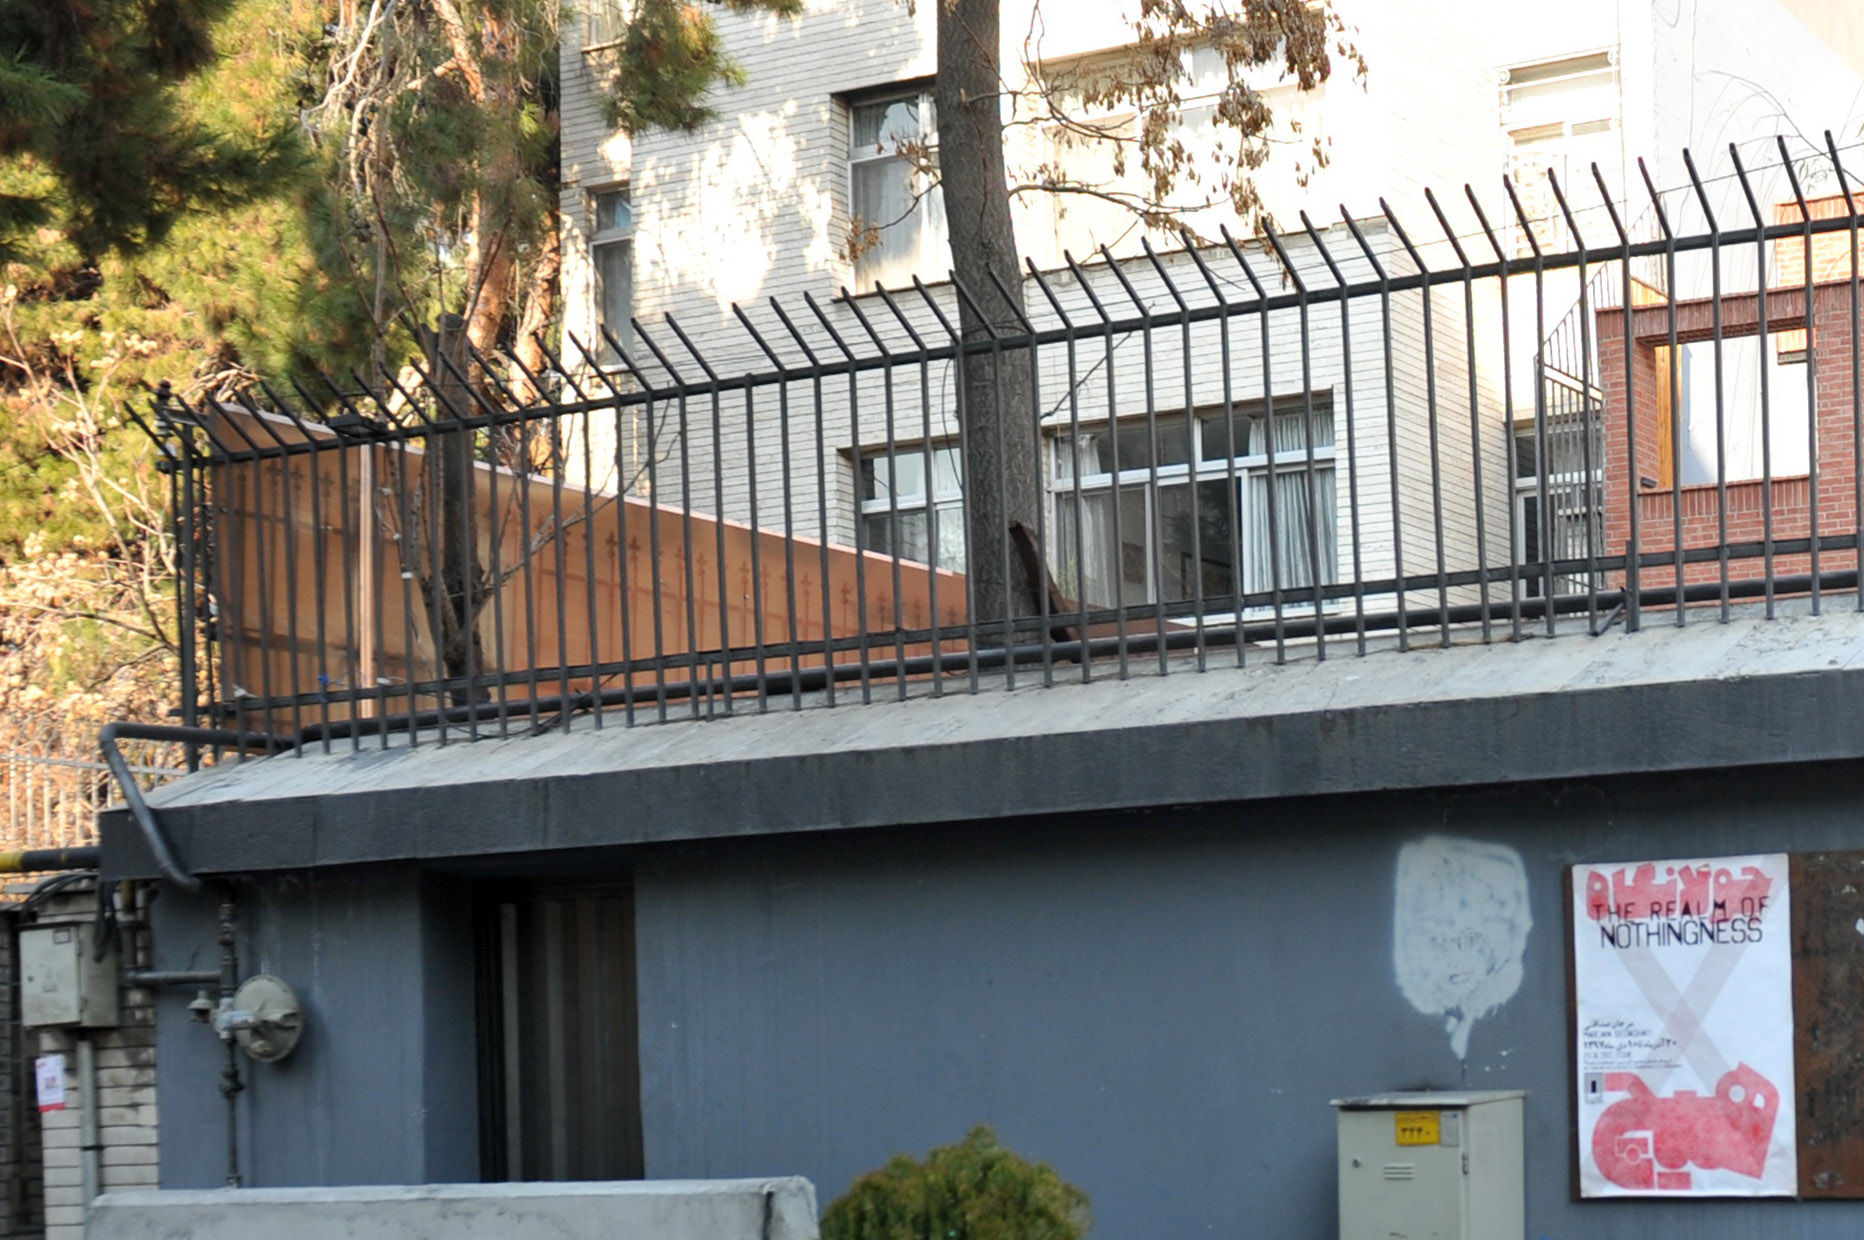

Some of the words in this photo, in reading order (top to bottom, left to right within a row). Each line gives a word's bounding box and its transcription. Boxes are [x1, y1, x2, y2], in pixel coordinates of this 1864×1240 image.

[1592, 902, 1636, 924] THE
[1650, 898, 1727, 922] REALM
[1741, 896, 1770, 918] OF
[1600, 918, 1764, 949] NOTHINGNESS
